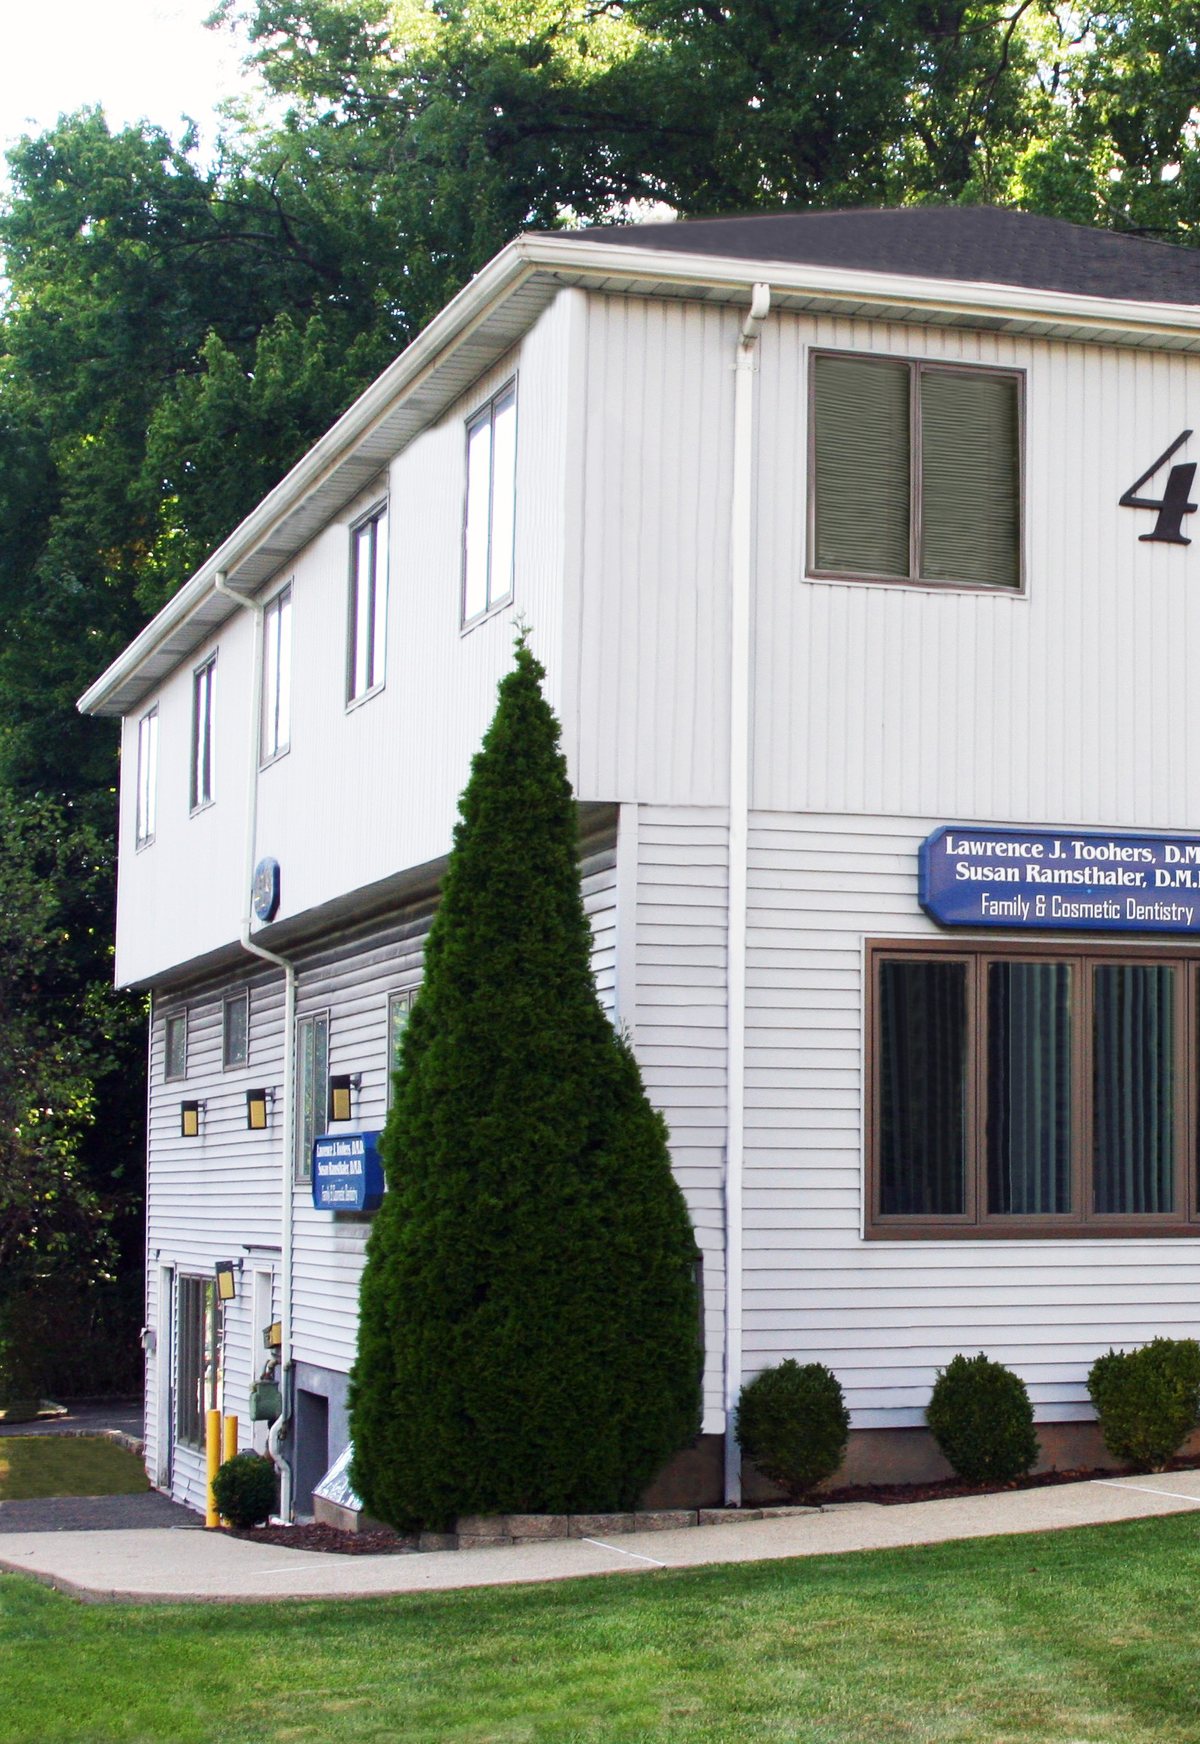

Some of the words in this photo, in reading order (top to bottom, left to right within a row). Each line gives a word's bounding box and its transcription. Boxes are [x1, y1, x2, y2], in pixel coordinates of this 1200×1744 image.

[946, 836, 1043, 859] Lawrence
[1049, 841, 1066, 859] J.
[1071, 841, 1157, 864] Toohers,
[956, 861, 1020, 882] Susan
[1025, 864, 1147, 888] Ramsthaler,
[982, 893, 1030, 920] Family
[1036, 895, 1046, 916] &
[1052, 895, 1120, 919] Cosmetic
[1127, 900, 1194, 925] Dentistry
